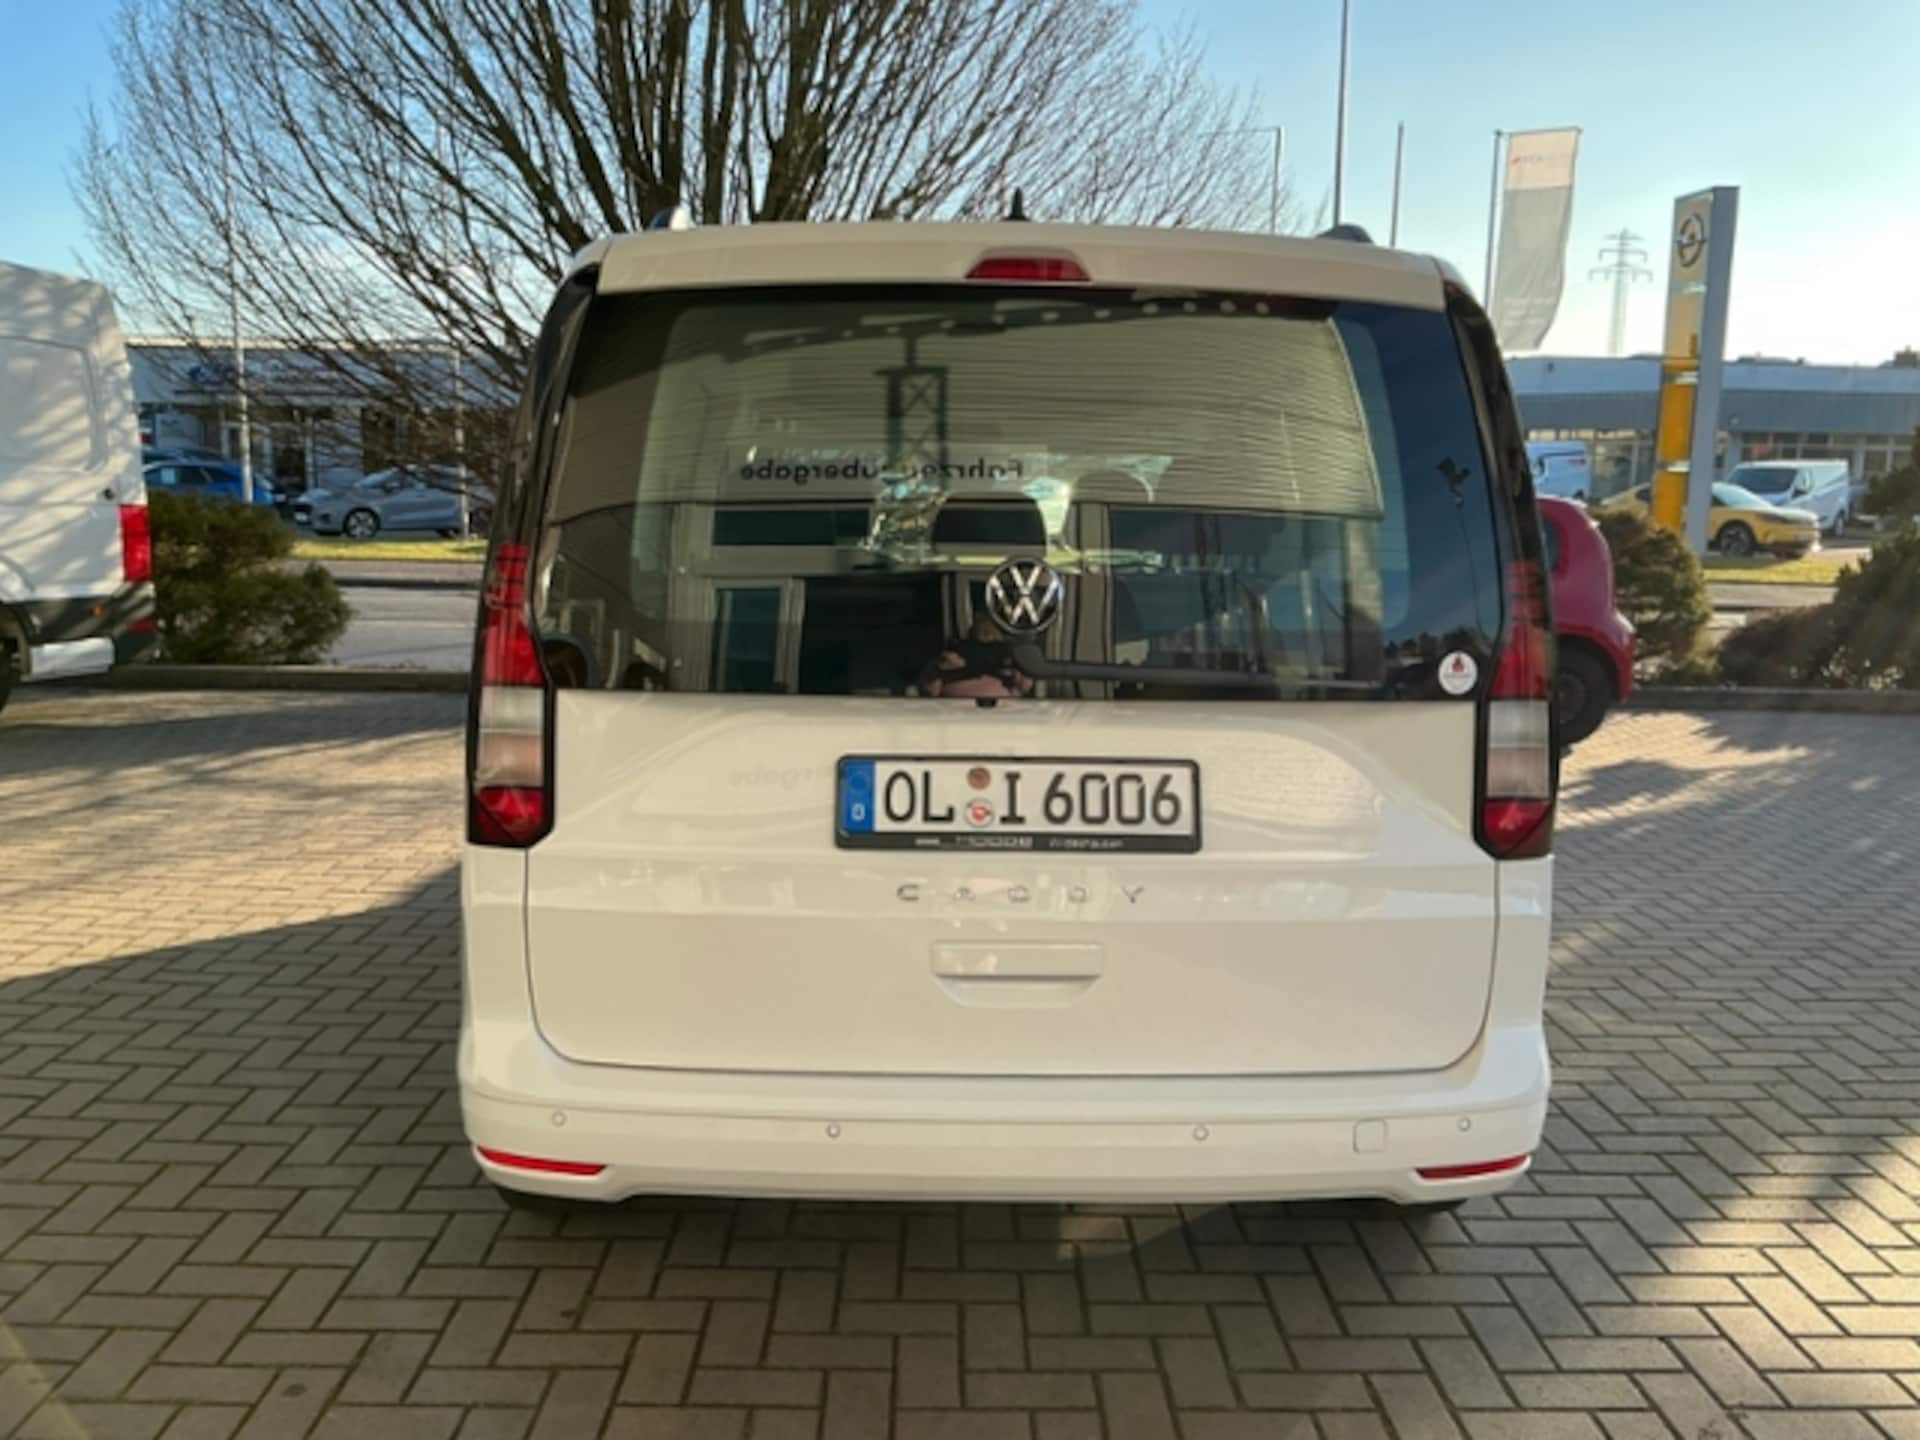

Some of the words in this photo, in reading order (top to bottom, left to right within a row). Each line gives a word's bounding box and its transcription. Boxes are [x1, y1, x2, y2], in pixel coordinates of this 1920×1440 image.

[884, 770, 954, 823] OL
[999, 771, 1026, 825] I
[1043, 772, 1182, 826] 6006
[896, 884, 1144, 904] CADDY
